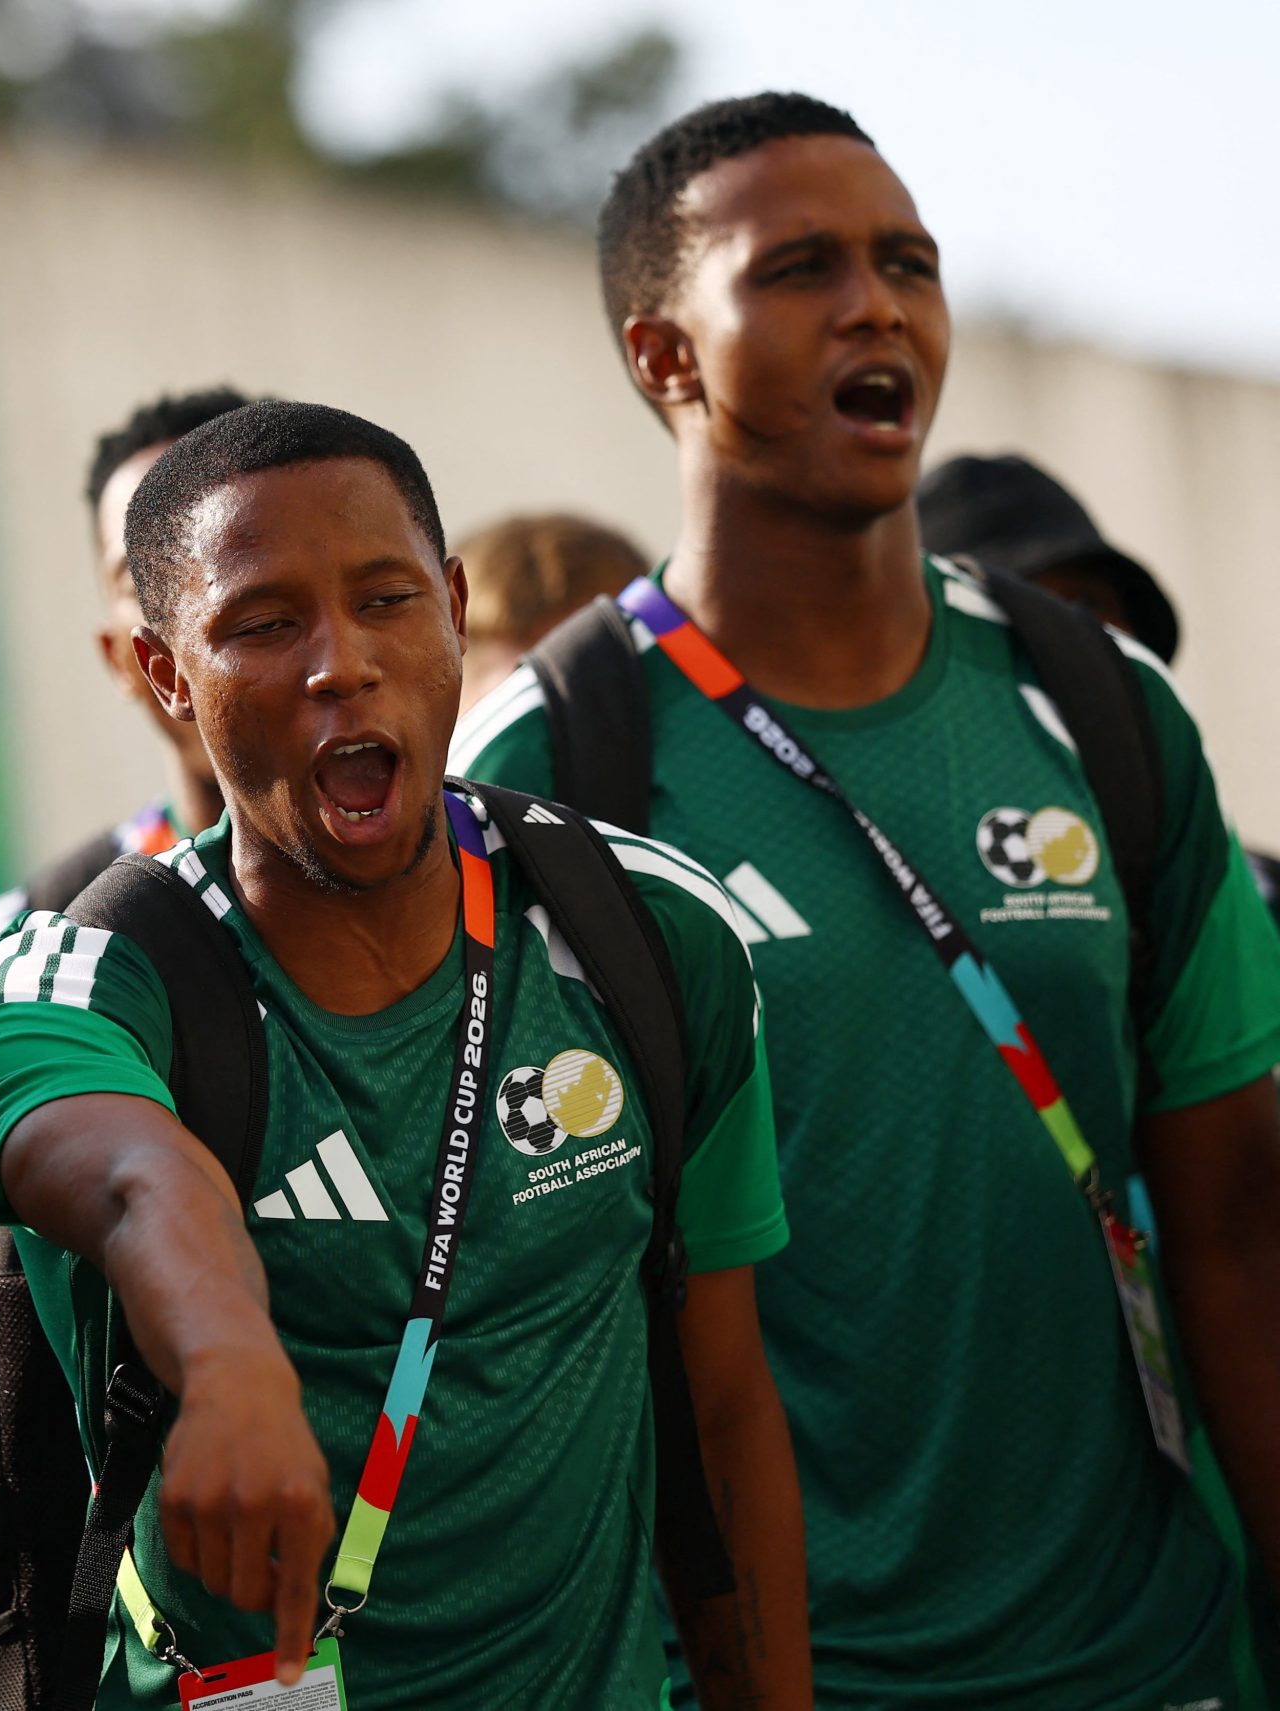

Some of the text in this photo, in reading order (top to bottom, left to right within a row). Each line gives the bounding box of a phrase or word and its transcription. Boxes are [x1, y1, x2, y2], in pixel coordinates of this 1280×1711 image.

[425, 972, 487, 1290] FIFA WORLD CUP 2026
[528, 1138, 627, 1183] SOUTH AFRICAN
[512, 1174, 573, 1206] FOOTBALL
[192, 1694, 237, 1710] ACCREDITATION
[237, 1690, 253, 1699] PASS
